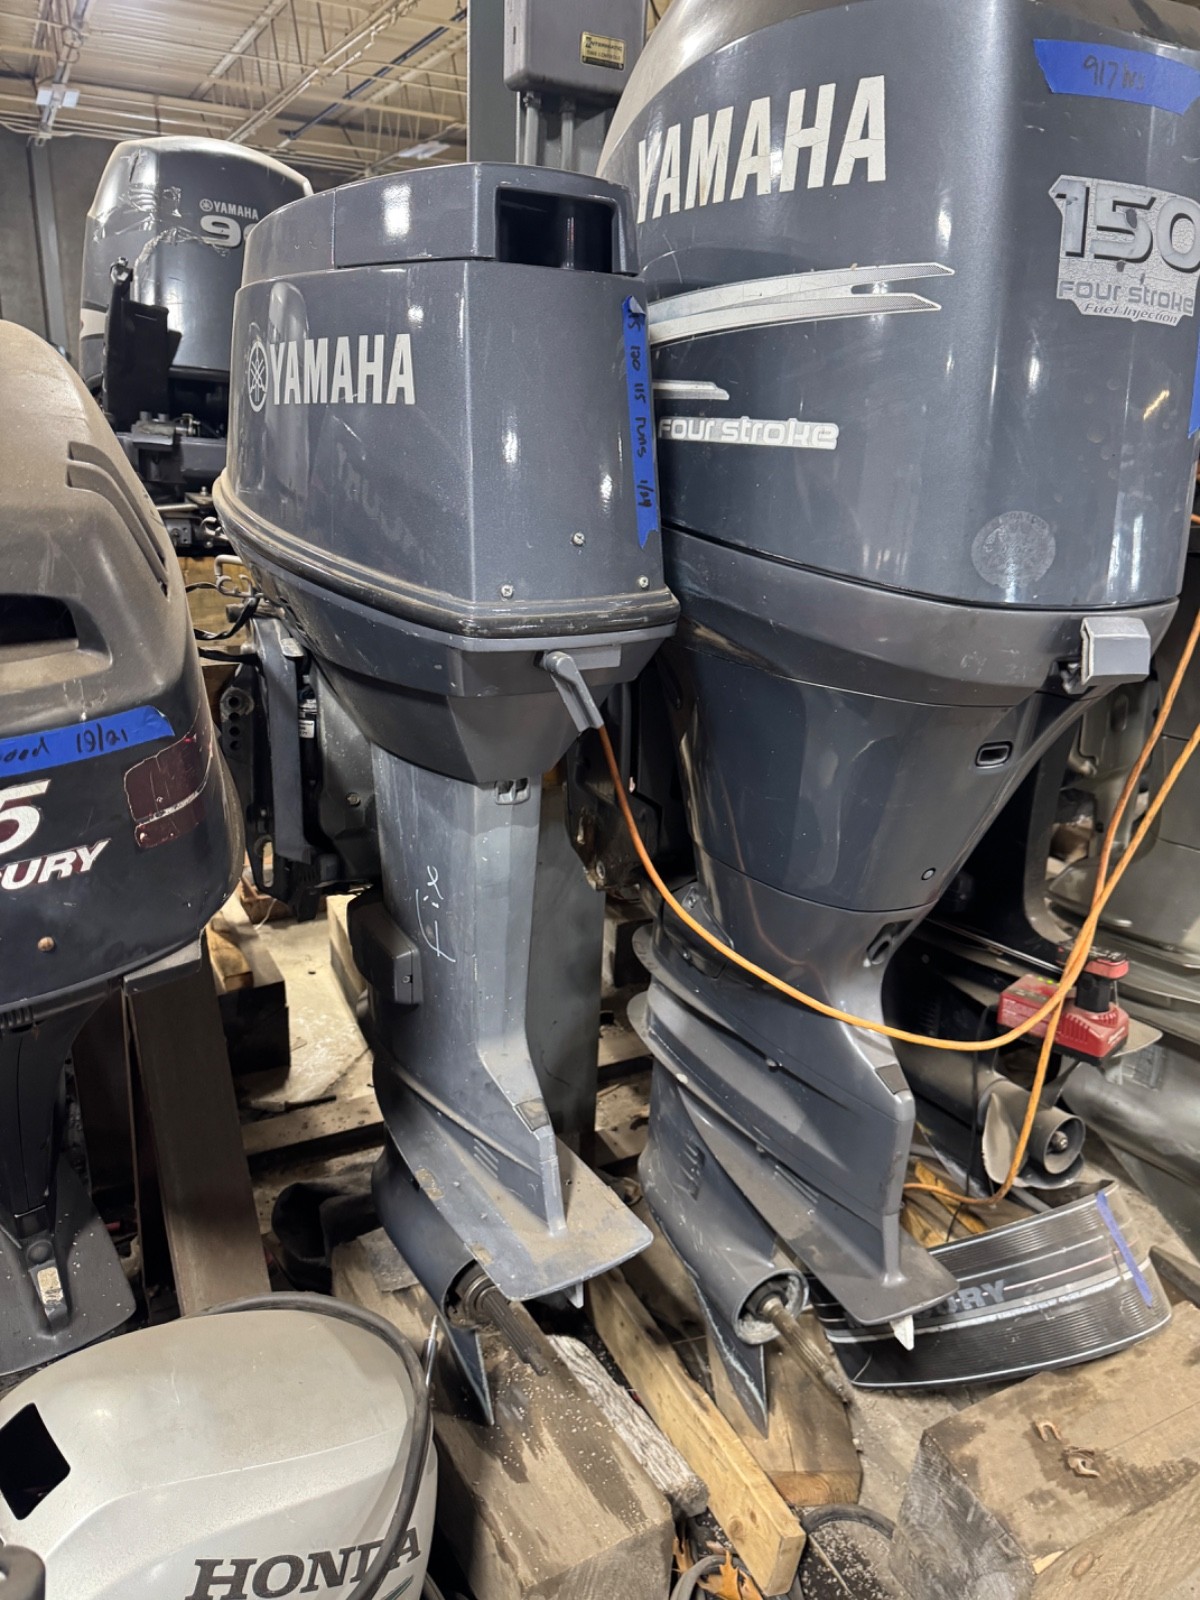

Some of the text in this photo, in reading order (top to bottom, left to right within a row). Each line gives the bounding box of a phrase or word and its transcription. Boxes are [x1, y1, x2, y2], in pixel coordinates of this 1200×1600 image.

[1083, 54, 1119, 91] 917
[637, 75, 887, 225] YAMAHA
[213, 200, 260, 221] YAMAHA
[1050, 177, 1200, 275] 150
[1084, 303, 1178, 324] Fuel Injection
[269, 333, 416, 406] YAMAHA
[0, 837, 112, 891] URY
